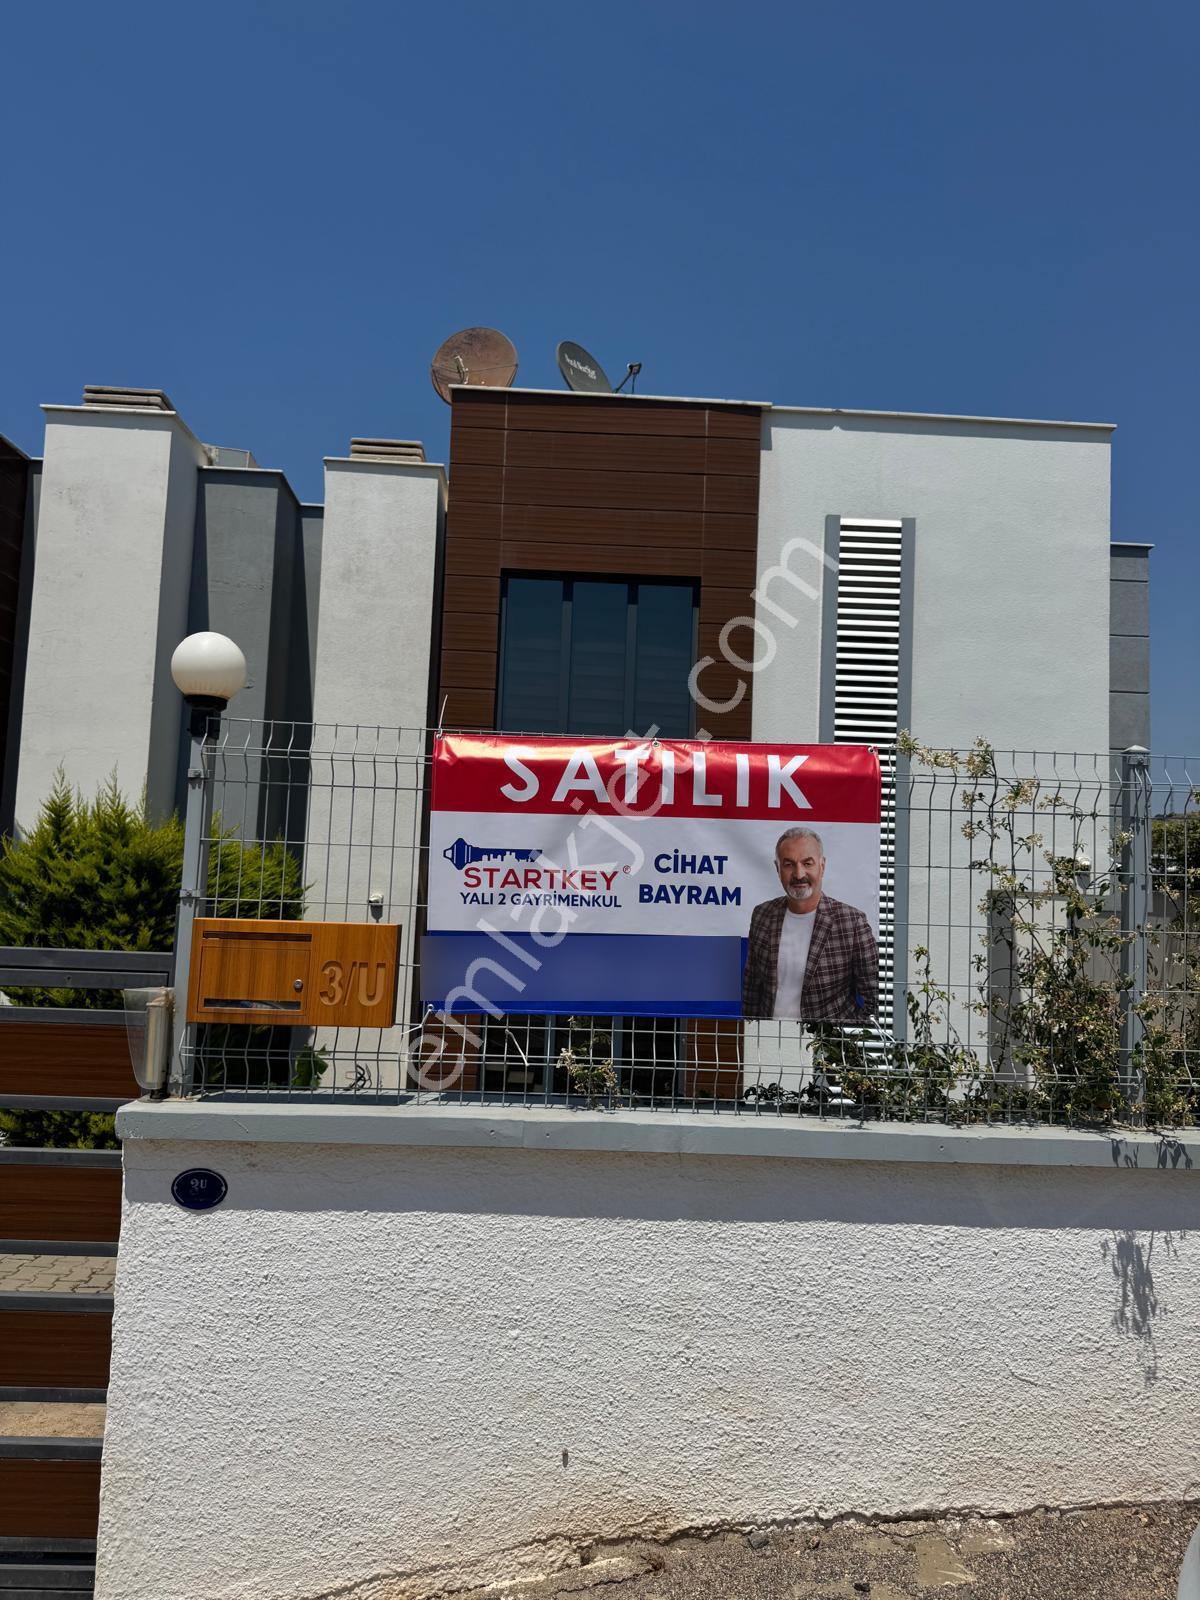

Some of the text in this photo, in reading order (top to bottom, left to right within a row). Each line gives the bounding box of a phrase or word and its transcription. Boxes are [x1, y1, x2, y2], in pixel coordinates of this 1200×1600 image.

[500, 746, 812, 809] SATILIK
[654, 848, 728, 875] CİHAT
[463, 866, 618, 891] STARTKEY
[460, 890, 622, 908] YALI 2 GAYRİMENKUL
[639, 883, 742, 906] BAYRAM
[319, 960, 387, 1007] 3/U
